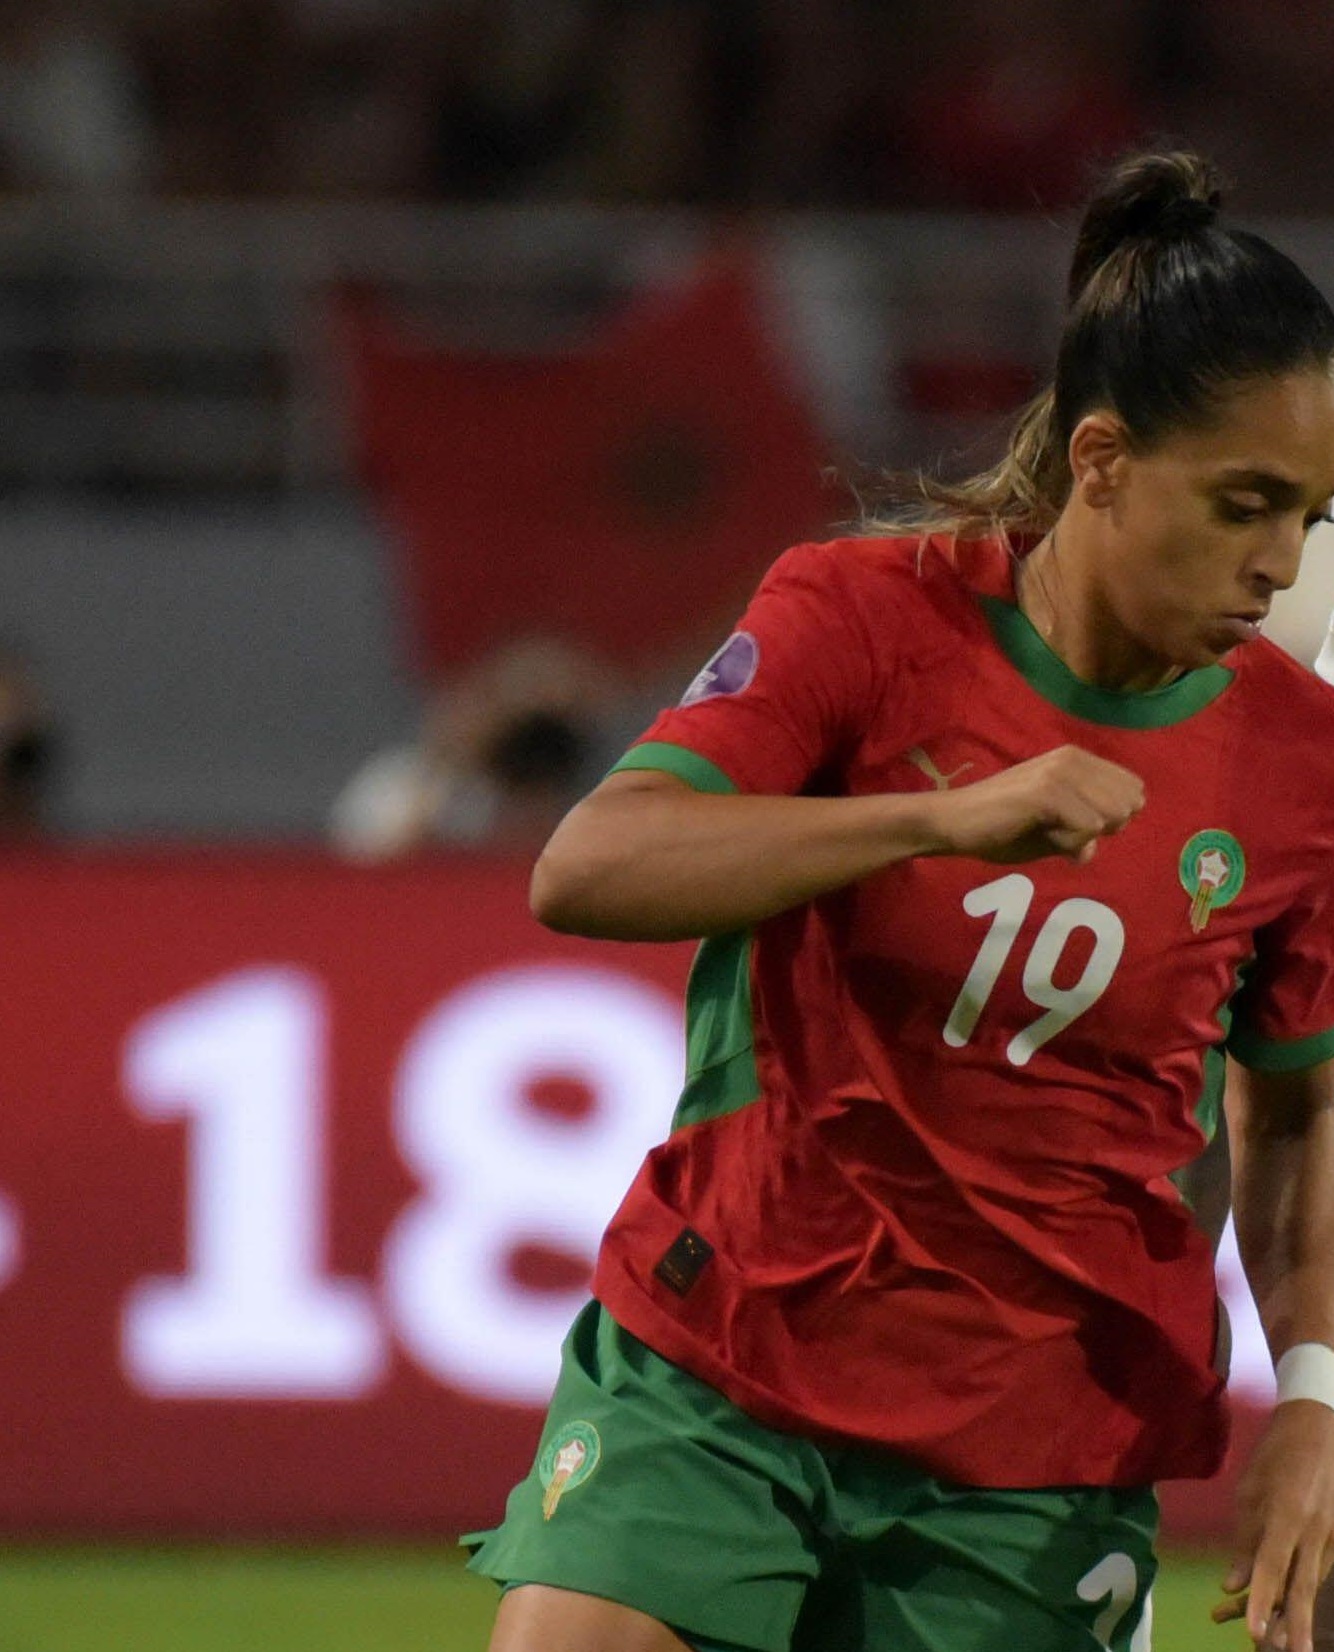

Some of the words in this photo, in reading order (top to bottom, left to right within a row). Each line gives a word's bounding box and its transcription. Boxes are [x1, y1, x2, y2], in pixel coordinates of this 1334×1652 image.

[943, 873, 1125, 1066] 19
[118, 963, 690, 1408] 18
[1076, 1552, 1154, 1652] 1
